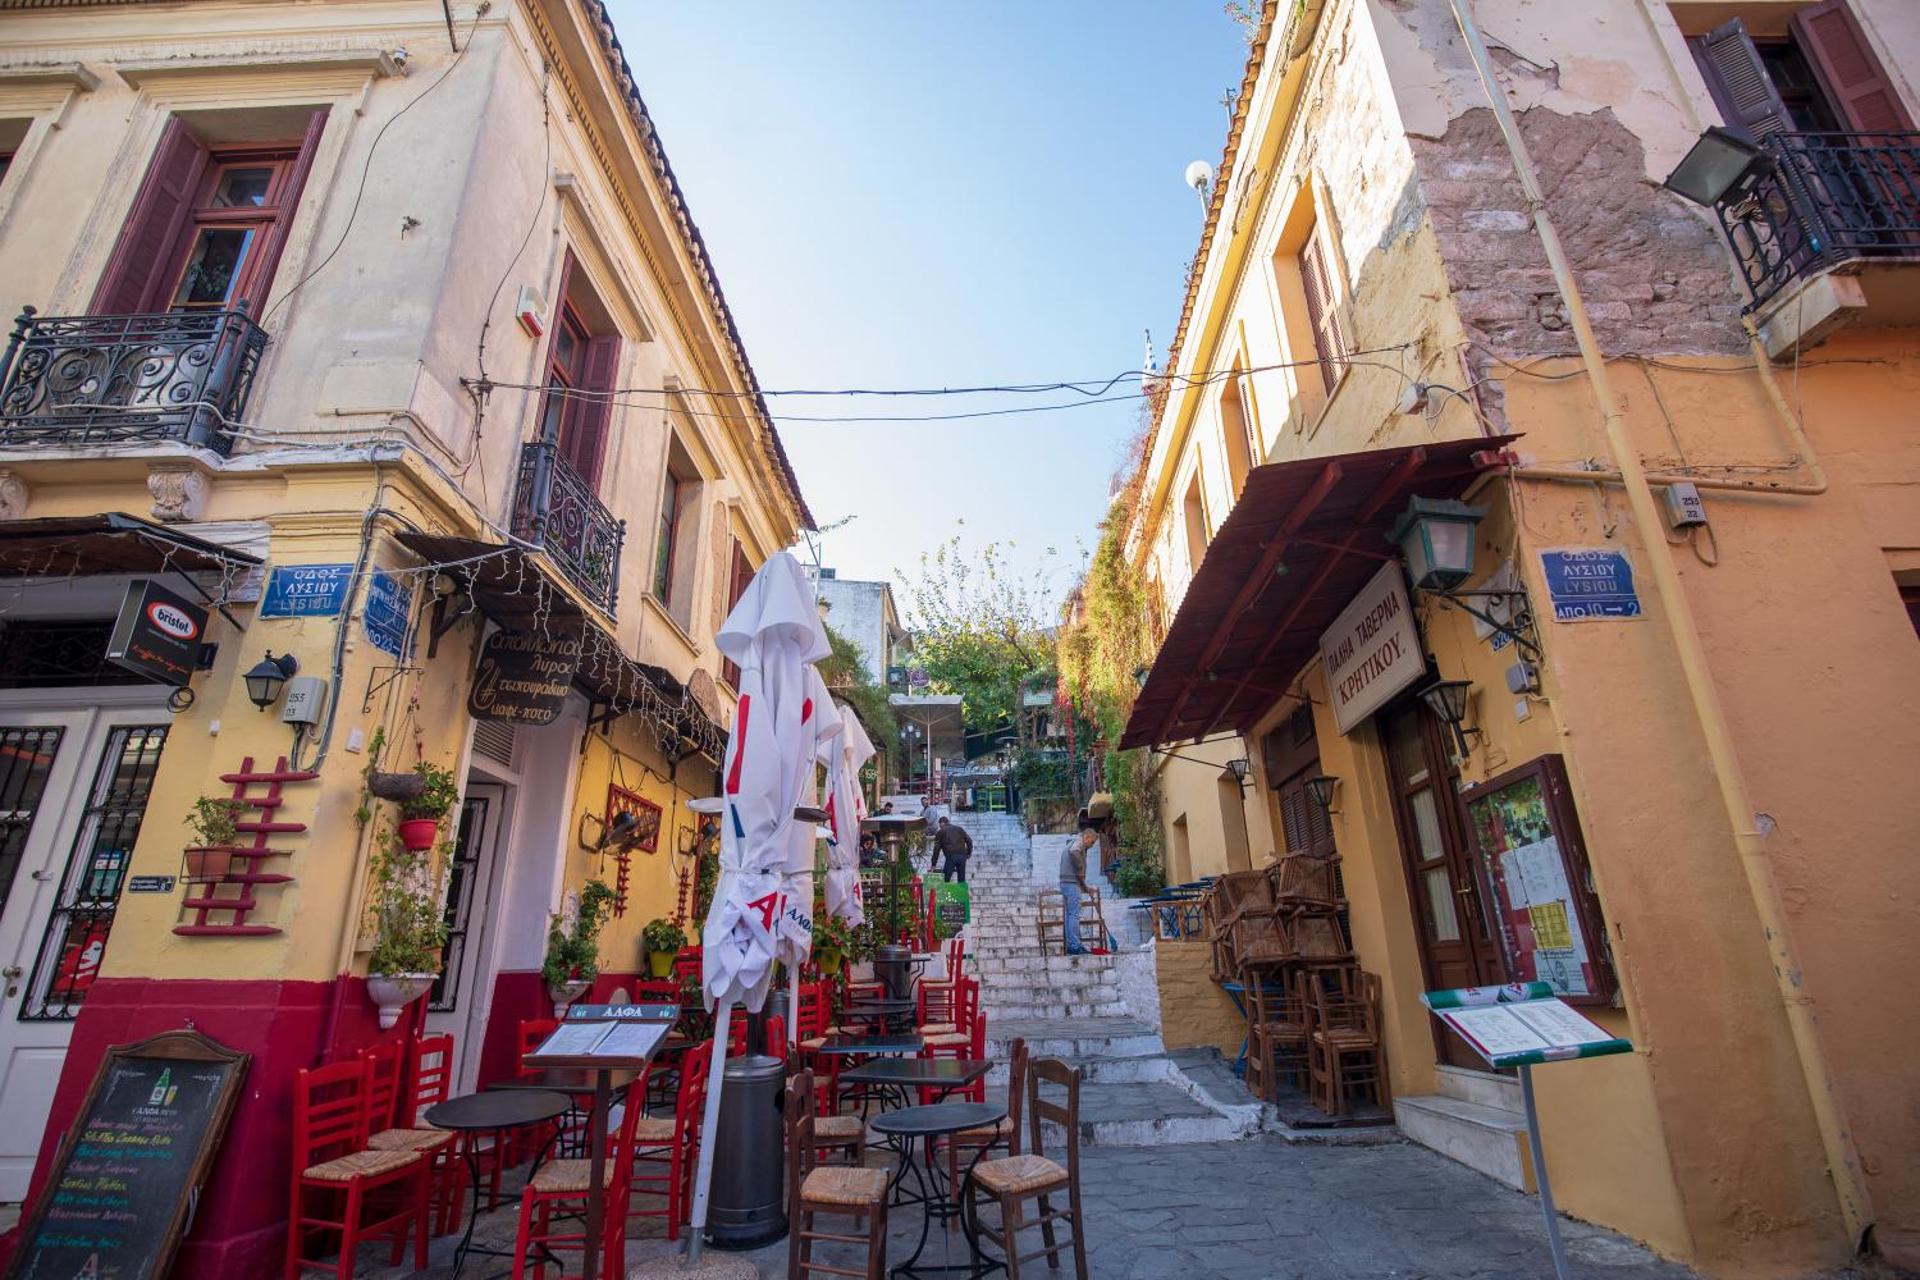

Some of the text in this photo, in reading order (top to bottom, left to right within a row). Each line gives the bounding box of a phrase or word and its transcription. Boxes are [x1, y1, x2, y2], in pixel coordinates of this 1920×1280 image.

[1682, 497, 1699, 505] 253
[1686, 510, 1699, 518] 22
[1561, 551, 1609, 561] ΟΔΟΣ
[294, 567, 340, 580] ΟΔΟΣ
[1563, 564, 1615, 576] ΛΥΣΙΟΥ
[285, 582, 339, 595] ΛΥΣΙΟΥ
[1564, 580, 1618, 593] LYSIOU
[157, 608, 190, 633] bristot
[1328, 591, 1401, 676] ΠΑΛΗΑ ΤΑΒΕΡΝΑ
[602, 1006, 643, 1017] ΑΛΦΑ
